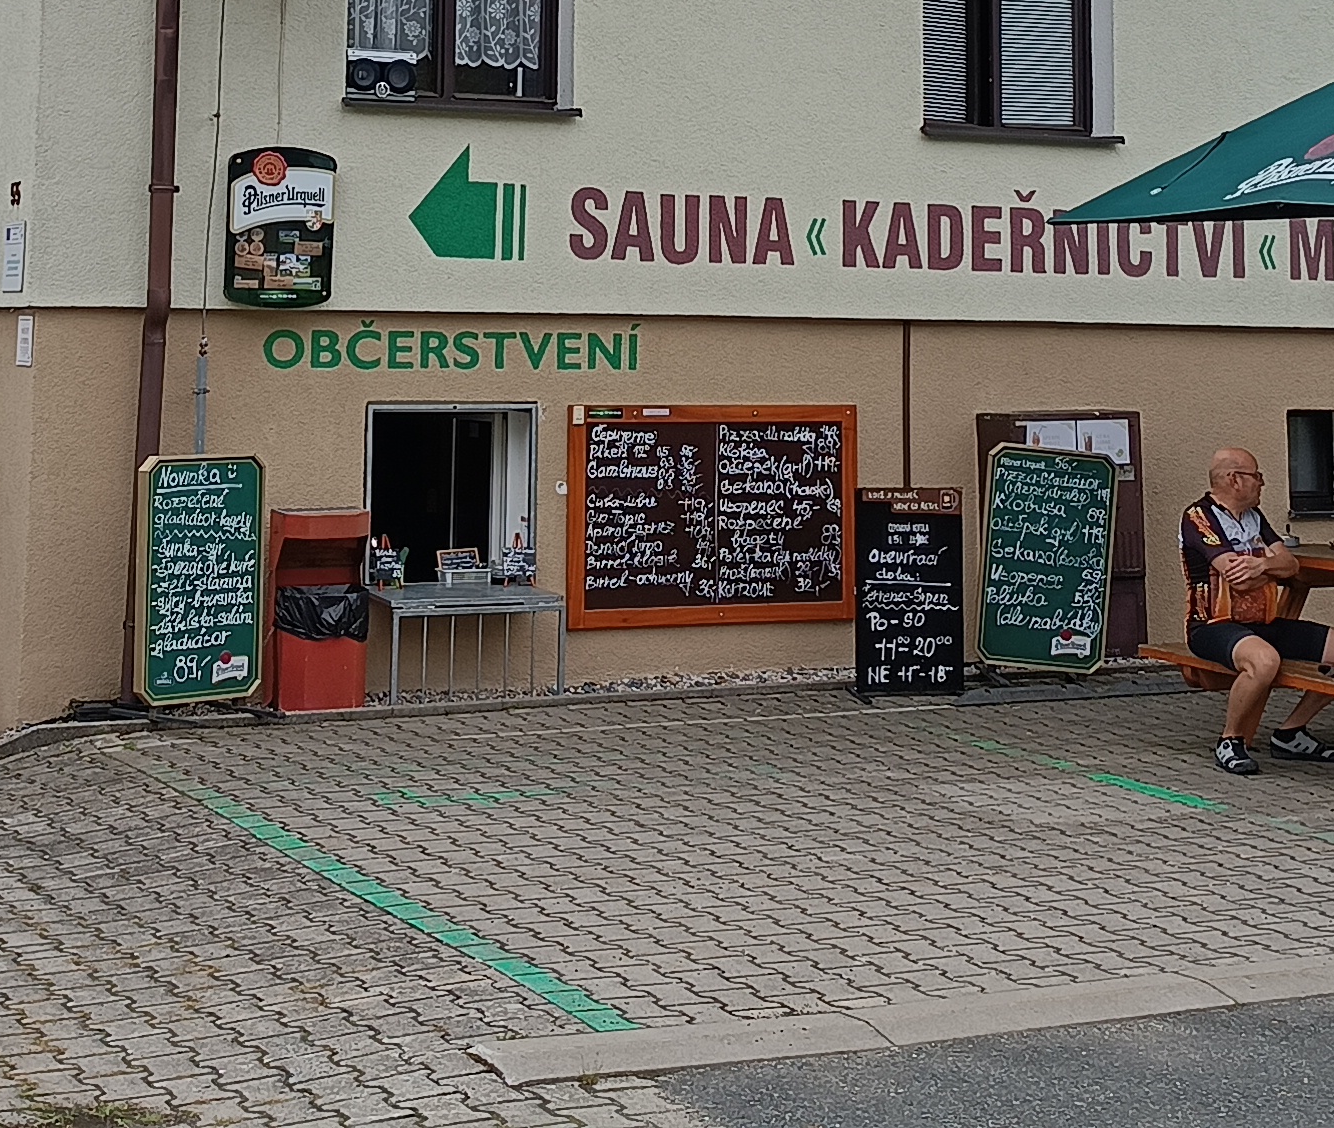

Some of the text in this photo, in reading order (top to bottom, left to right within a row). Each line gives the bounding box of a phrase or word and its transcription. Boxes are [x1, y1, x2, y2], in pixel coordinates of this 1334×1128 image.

[242, 184, 325, 215] Pilsner Urquell
[569, 186, 795, 266] SAUNA
[262, 319, 641, 371] OBČERSTVENÍ
[158, 462, 221, 487] Novinka
